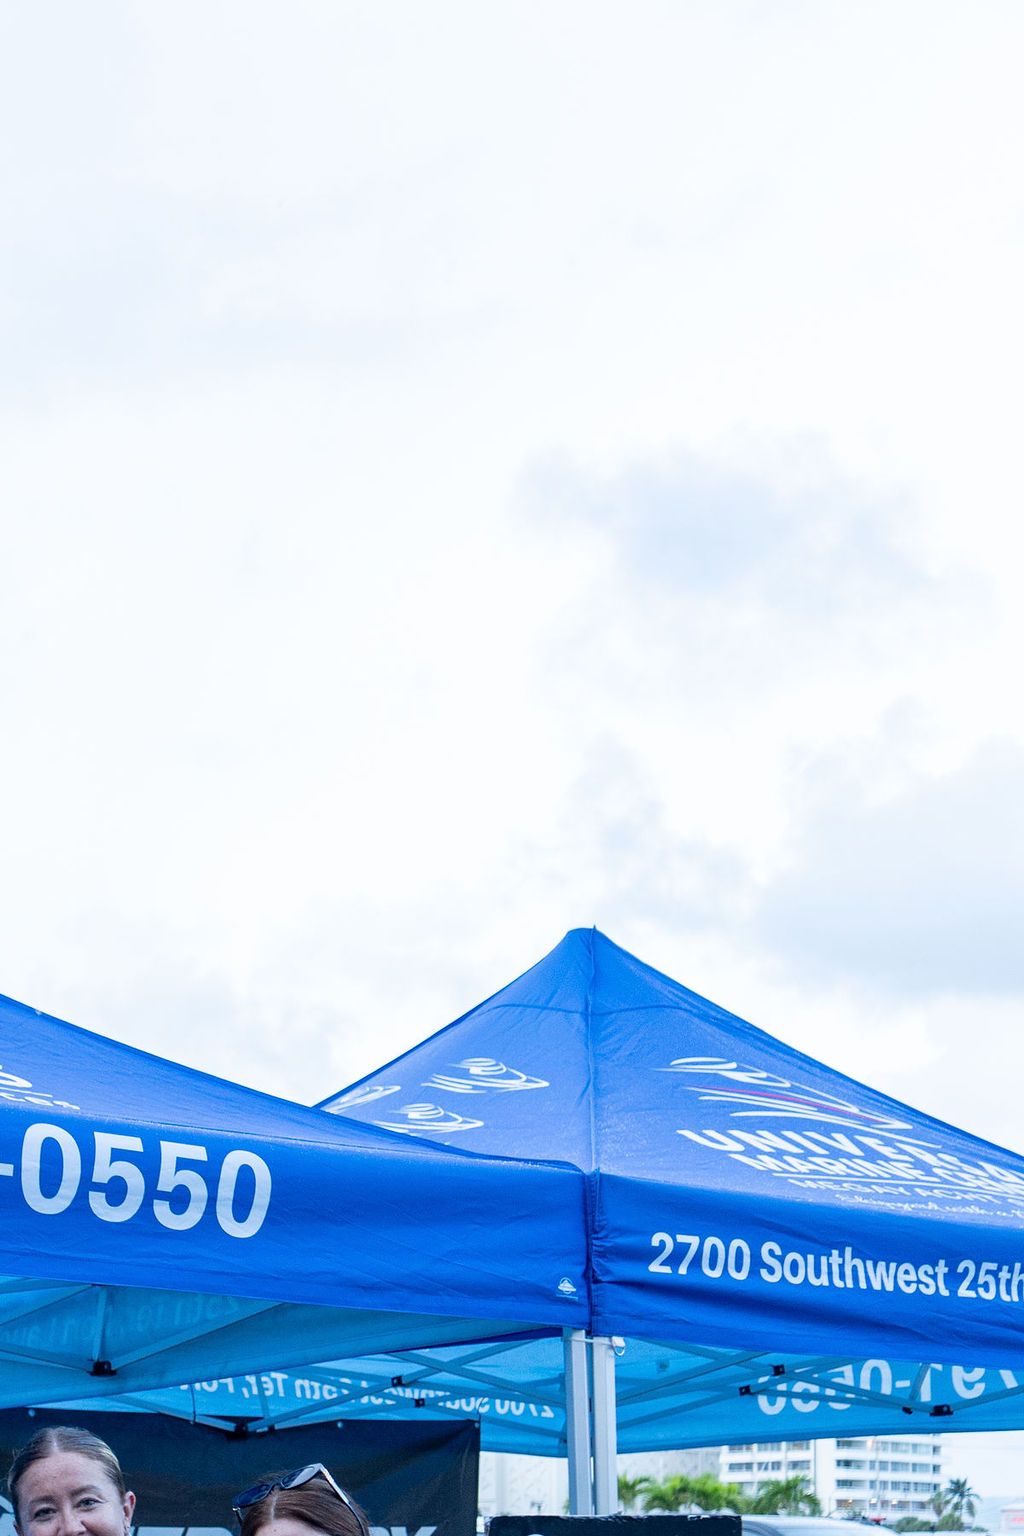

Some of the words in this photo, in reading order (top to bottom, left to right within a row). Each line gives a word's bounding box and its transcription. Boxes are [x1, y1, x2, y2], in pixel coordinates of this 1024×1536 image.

[677, 1129, 1024, 1184] UNIVERSA
[728, 1153, 942, 1183] MARINE
[648, 1231, 752, 1281] 2700
[759, 1240, 950, 1297] Southwest
[956, 1259, 1024, 1302] 25th
